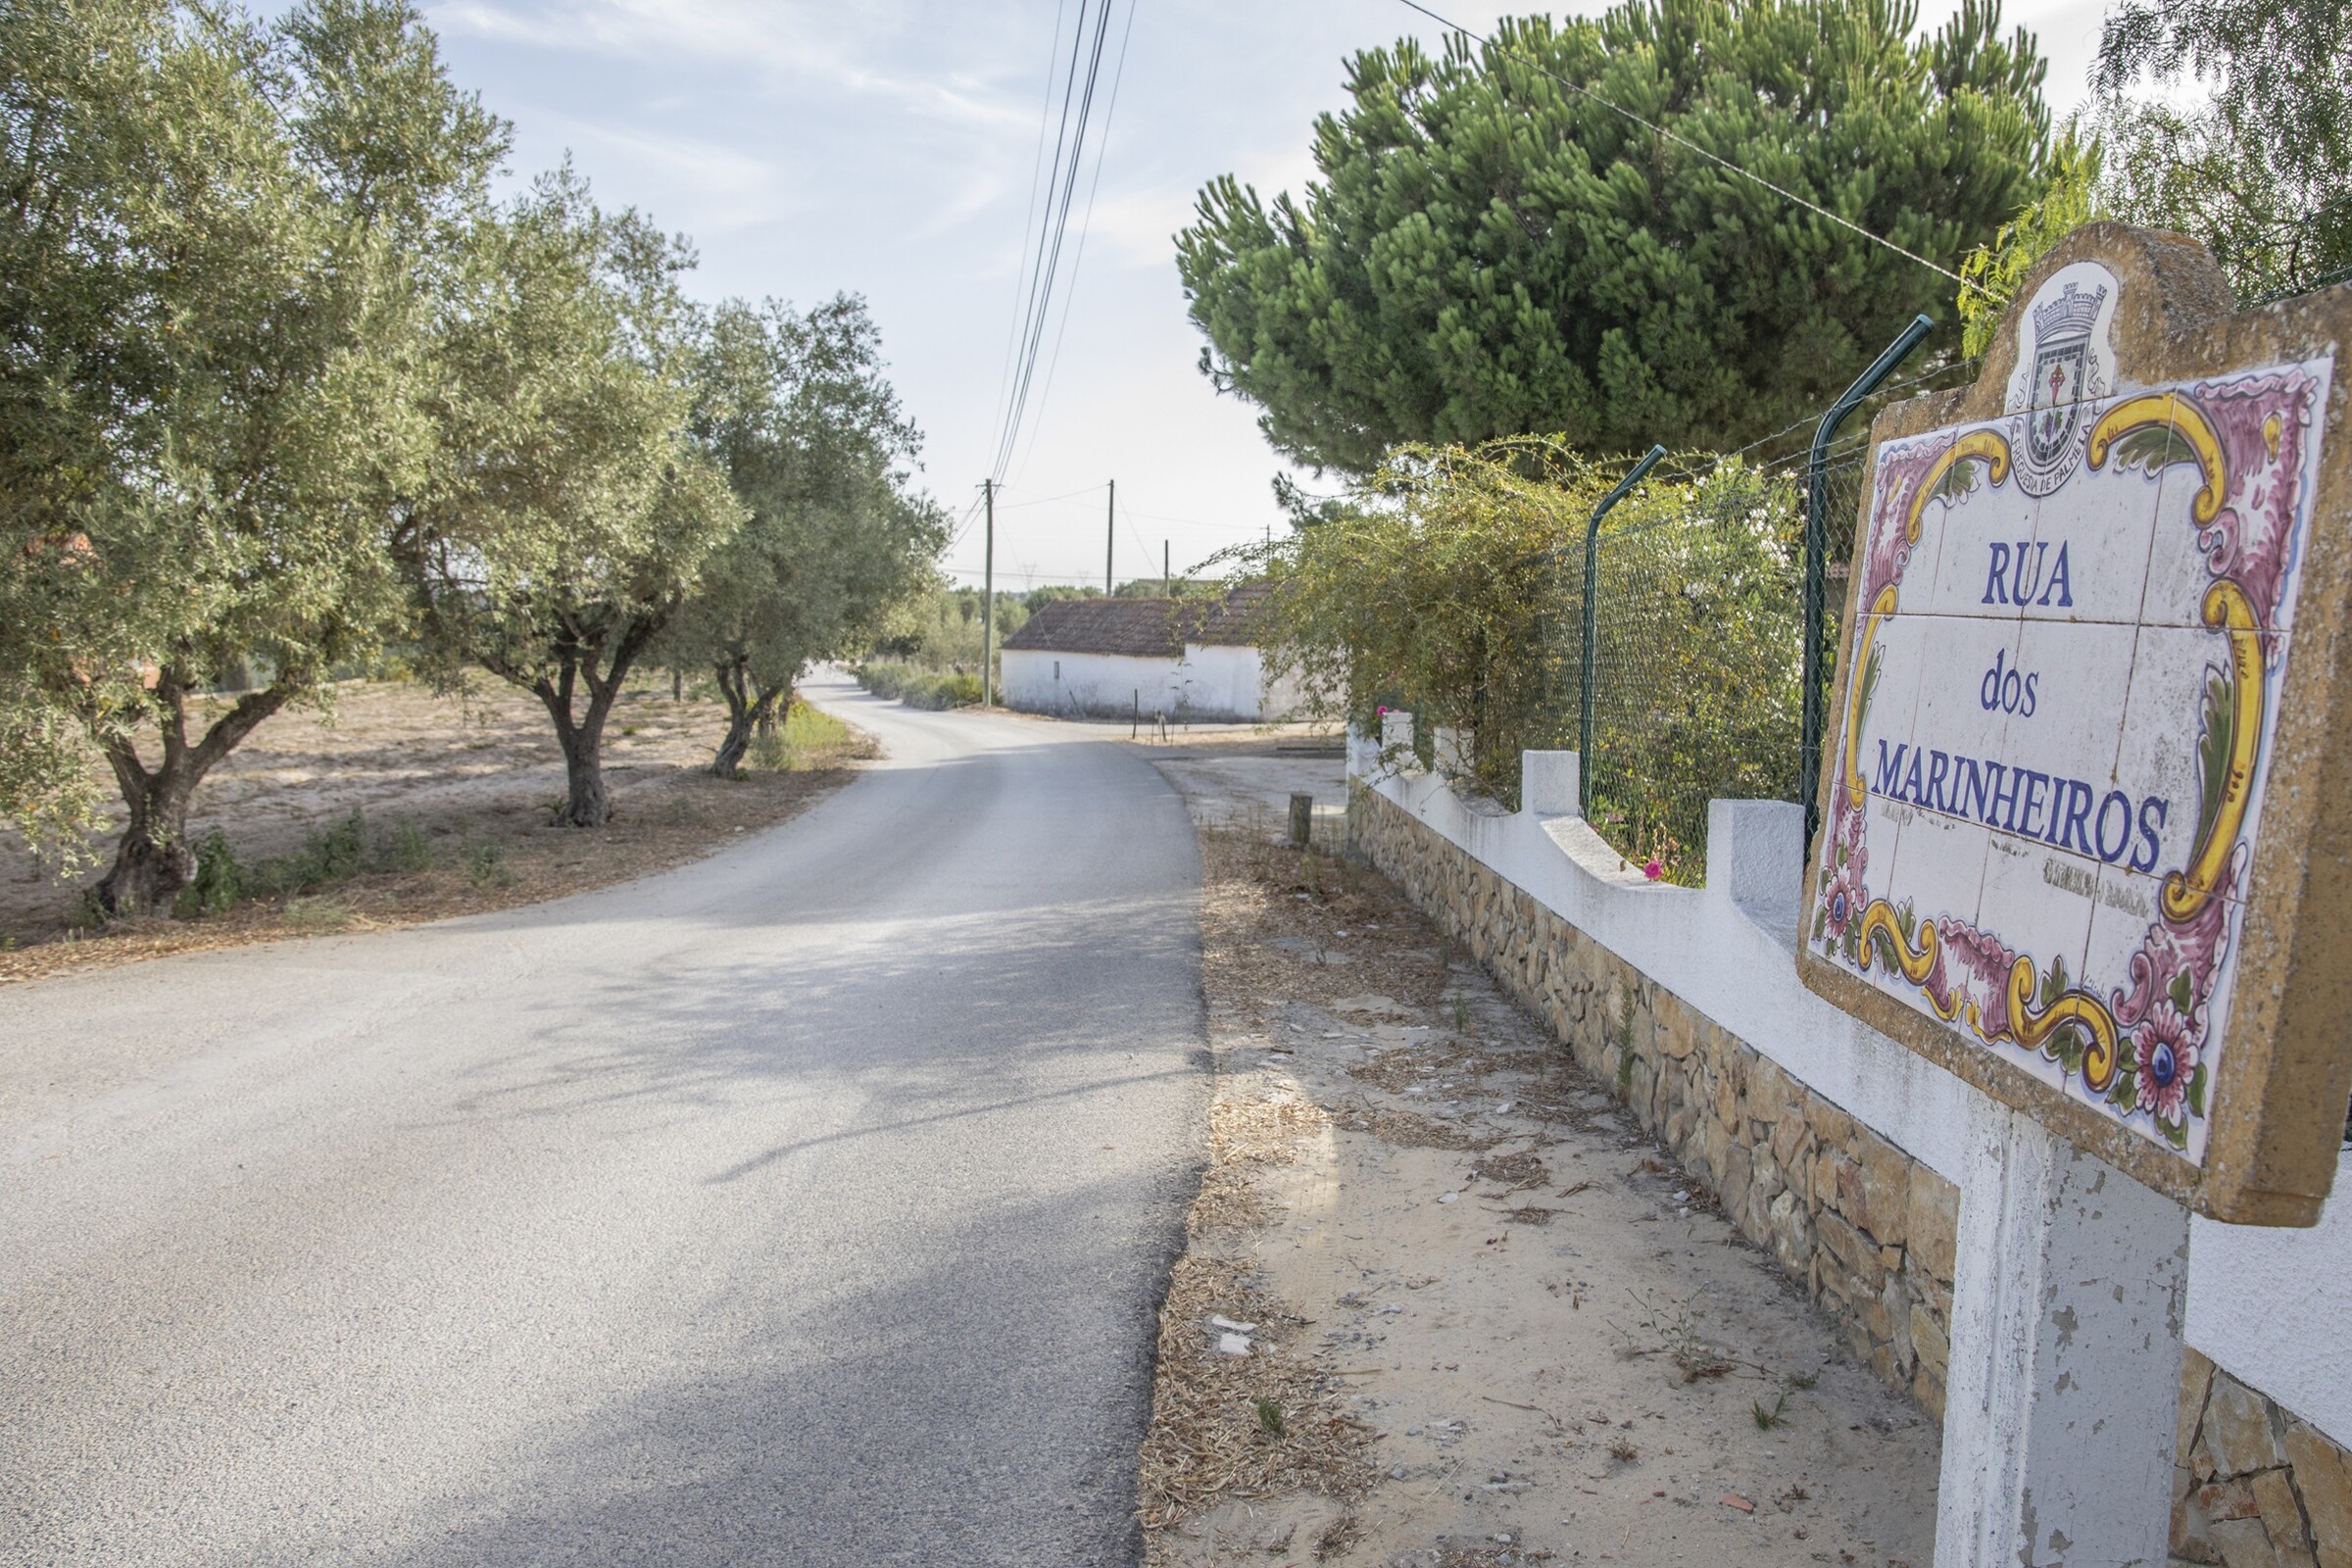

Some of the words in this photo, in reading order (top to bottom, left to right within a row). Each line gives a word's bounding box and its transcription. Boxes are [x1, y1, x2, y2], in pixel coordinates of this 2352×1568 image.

[2012, 438, 2037, 492] FREGUESIA
[2039, 476, 2051, 492] DE
[2054, 424, 2091, 485] PALMELA
[1982, 540, 2073, 608] RUA
[1981, 649, 2039, 717] dos
[1871, 738, 2169, 873] MARINHEIROS
